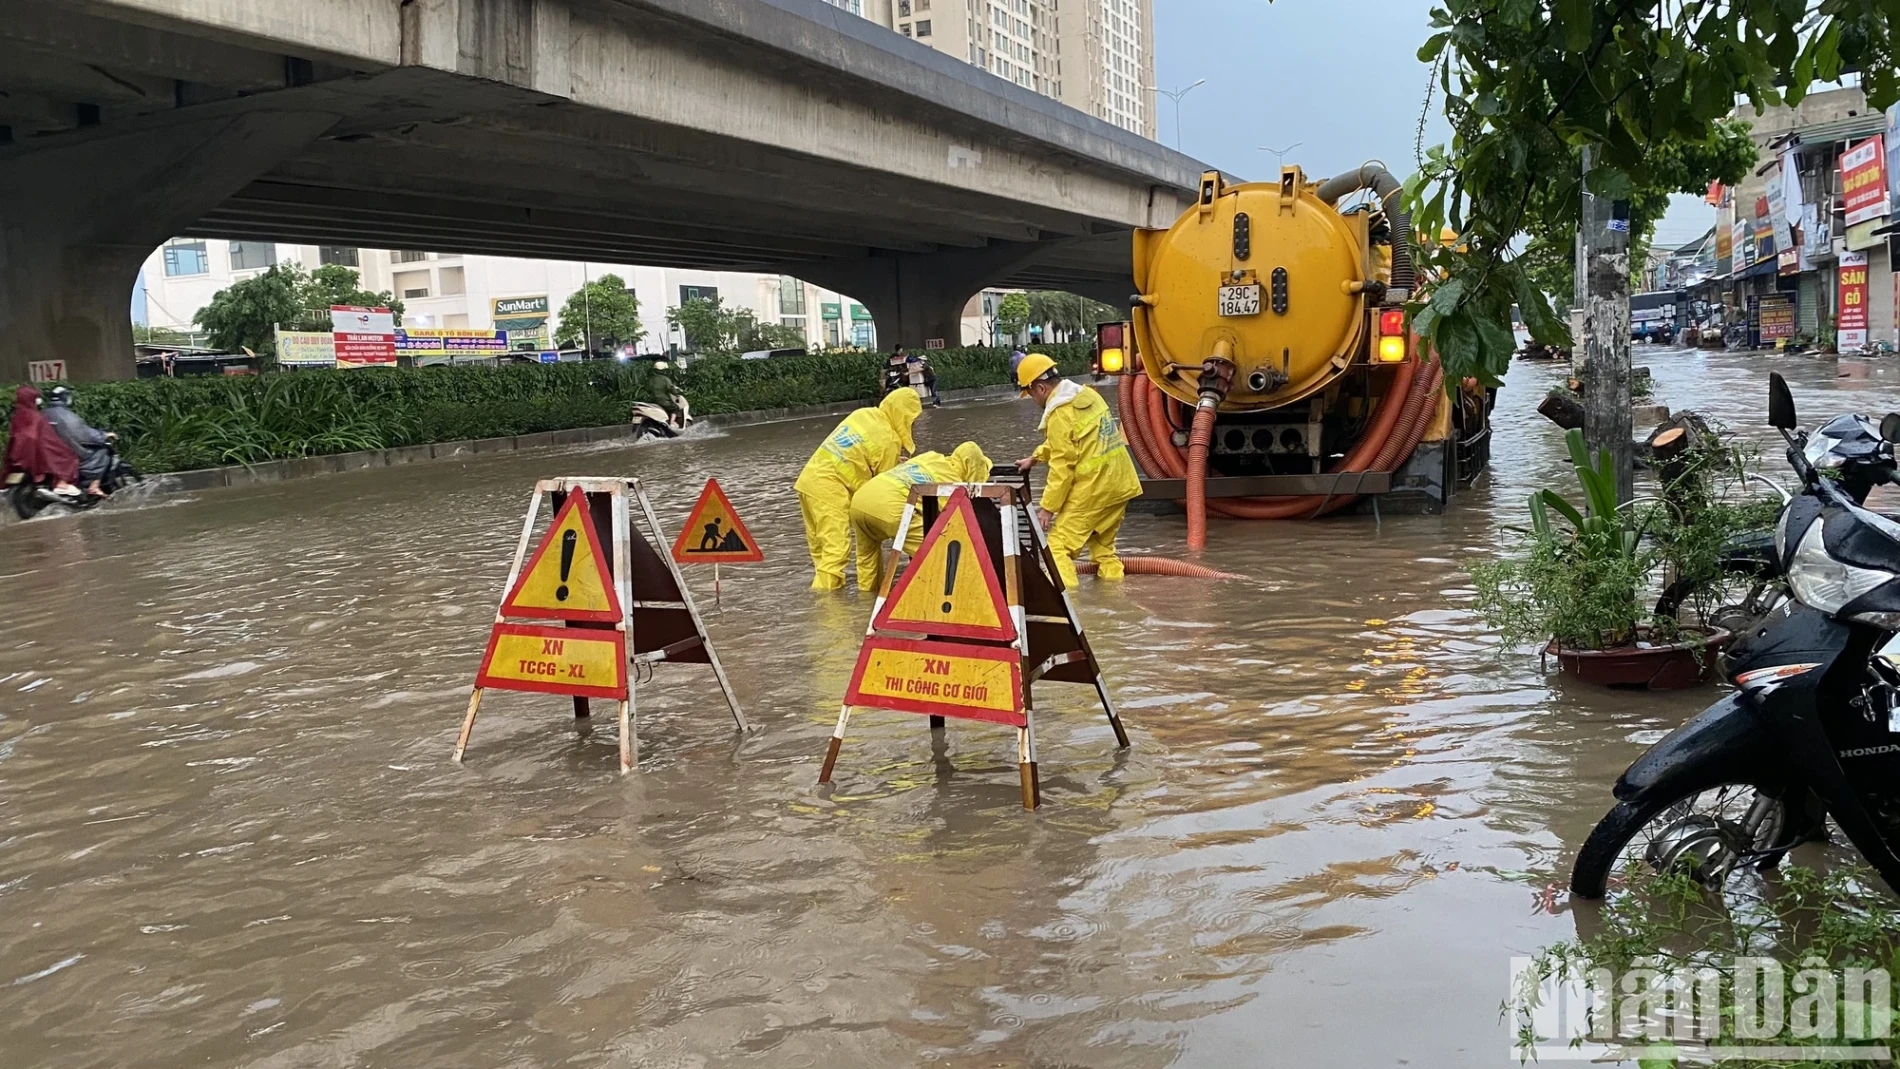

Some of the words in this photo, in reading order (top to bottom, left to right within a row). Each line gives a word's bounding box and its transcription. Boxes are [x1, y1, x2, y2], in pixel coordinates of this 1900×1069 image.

[1841, 270, 1865, 285] SÀN
[1228, 287, 1250, 300] 29C
[1845, 287, 1861, 305] GỖ
[497, 299, 541, 312] SunMart
[1221, 300, 1258, 315] 184.47
[541, 639, 564, 656] XN
[519, 660, 556, 676] TCCG
[568, 664, 585, 679] XL
[923, 659, 950, 675] XN
[885, 676, 903, 692] THI
[906, 677, 939, 696] CÔNG
[943, 683, 961, 698] CƠ
[1840, 745, 1900, 757] HONDA
